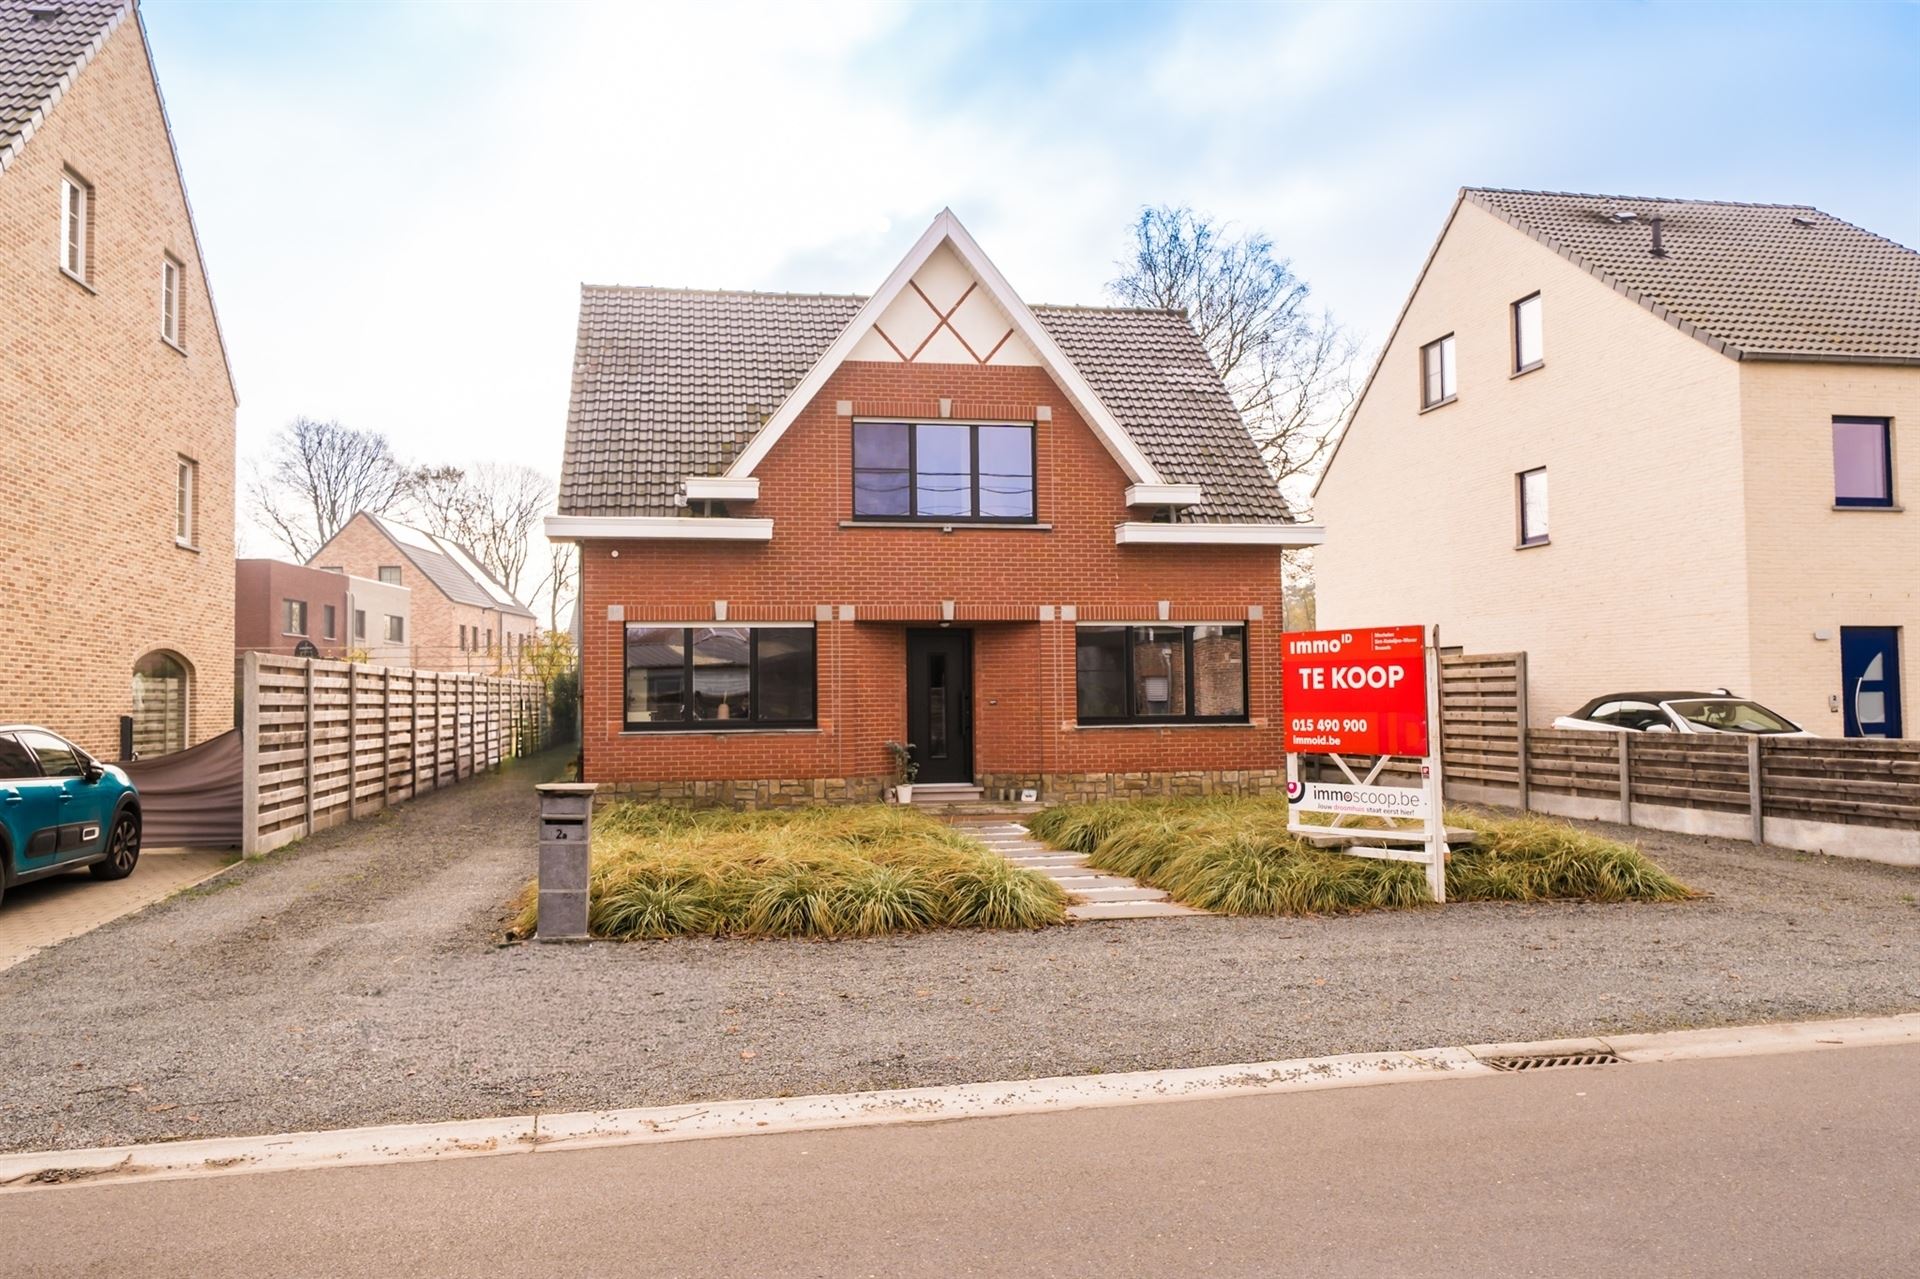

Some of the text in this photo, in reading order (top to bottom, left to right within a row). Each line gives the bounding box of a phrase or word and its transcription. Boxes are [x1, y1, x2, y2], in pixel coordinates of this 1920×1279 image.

[1299, 665, 1404, 689] TE KOOP
[1292, 719, 1367, 732] 015 490 900
[1292, 735, 1341, 745] immoid.be
[1313, 785, 1420, 808] immoscoop.be
